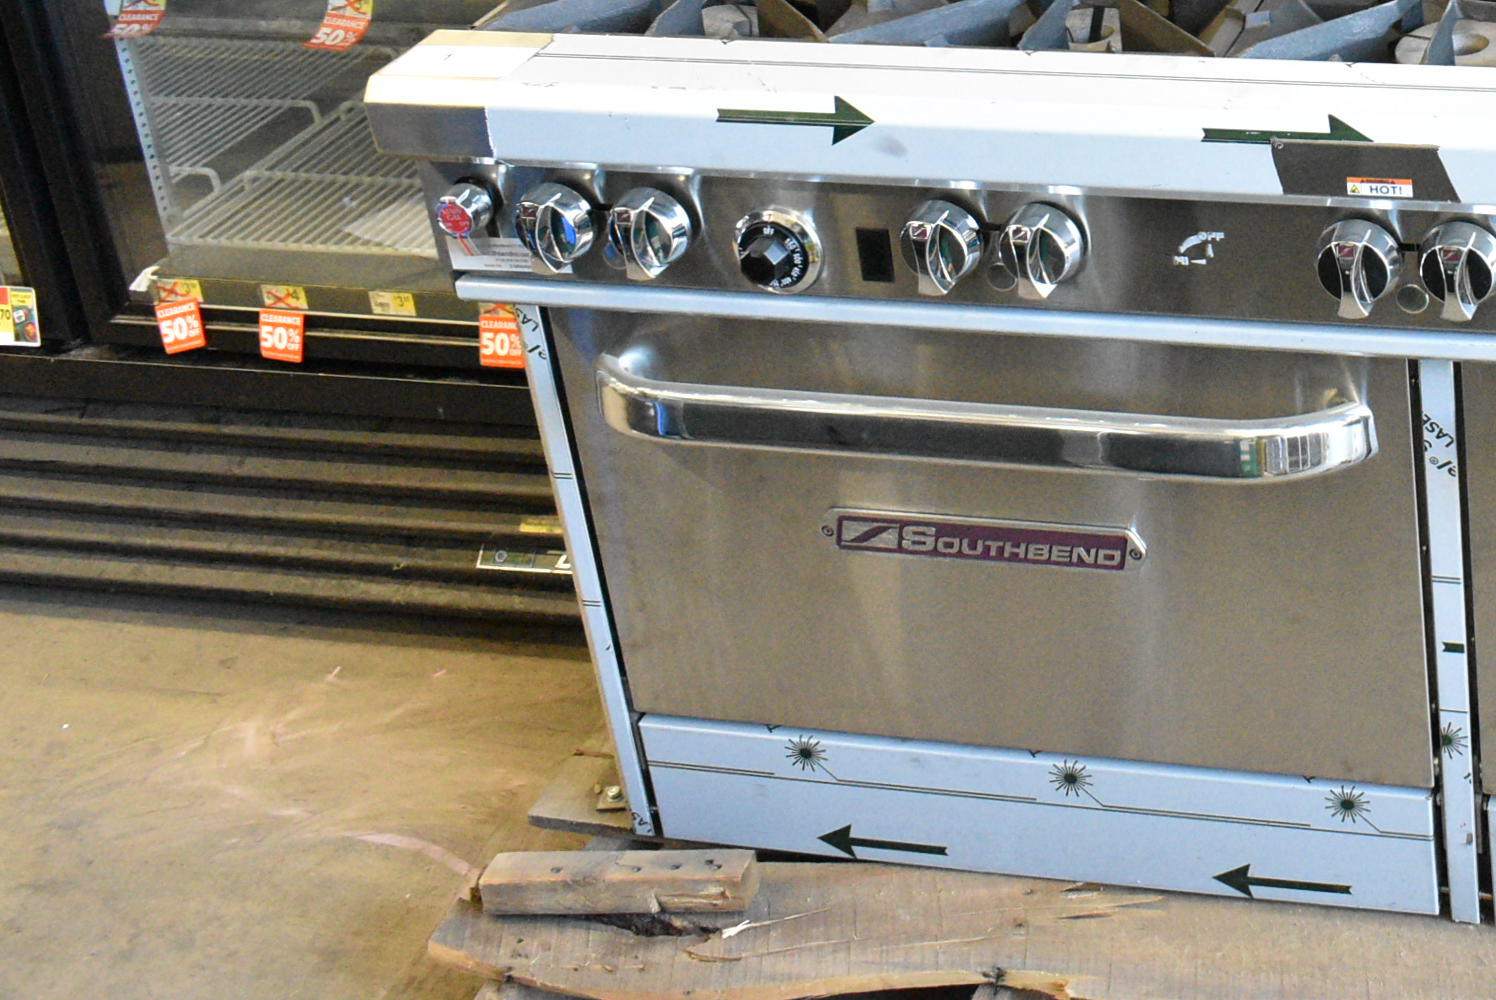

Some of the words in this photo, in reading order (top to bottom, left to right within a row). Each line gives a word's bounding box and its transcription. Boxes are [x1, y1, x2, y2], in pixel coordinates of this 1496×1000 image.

[1369, 185, 1402, 195] HOT!
[158, 302, 195, 317] CLEARANCE
[261, 314, 301, 325] CLEARANCE
[481, 320, 517, 330] CLEARAN
[901, 525, 1122, 566] SOUTHBEND
